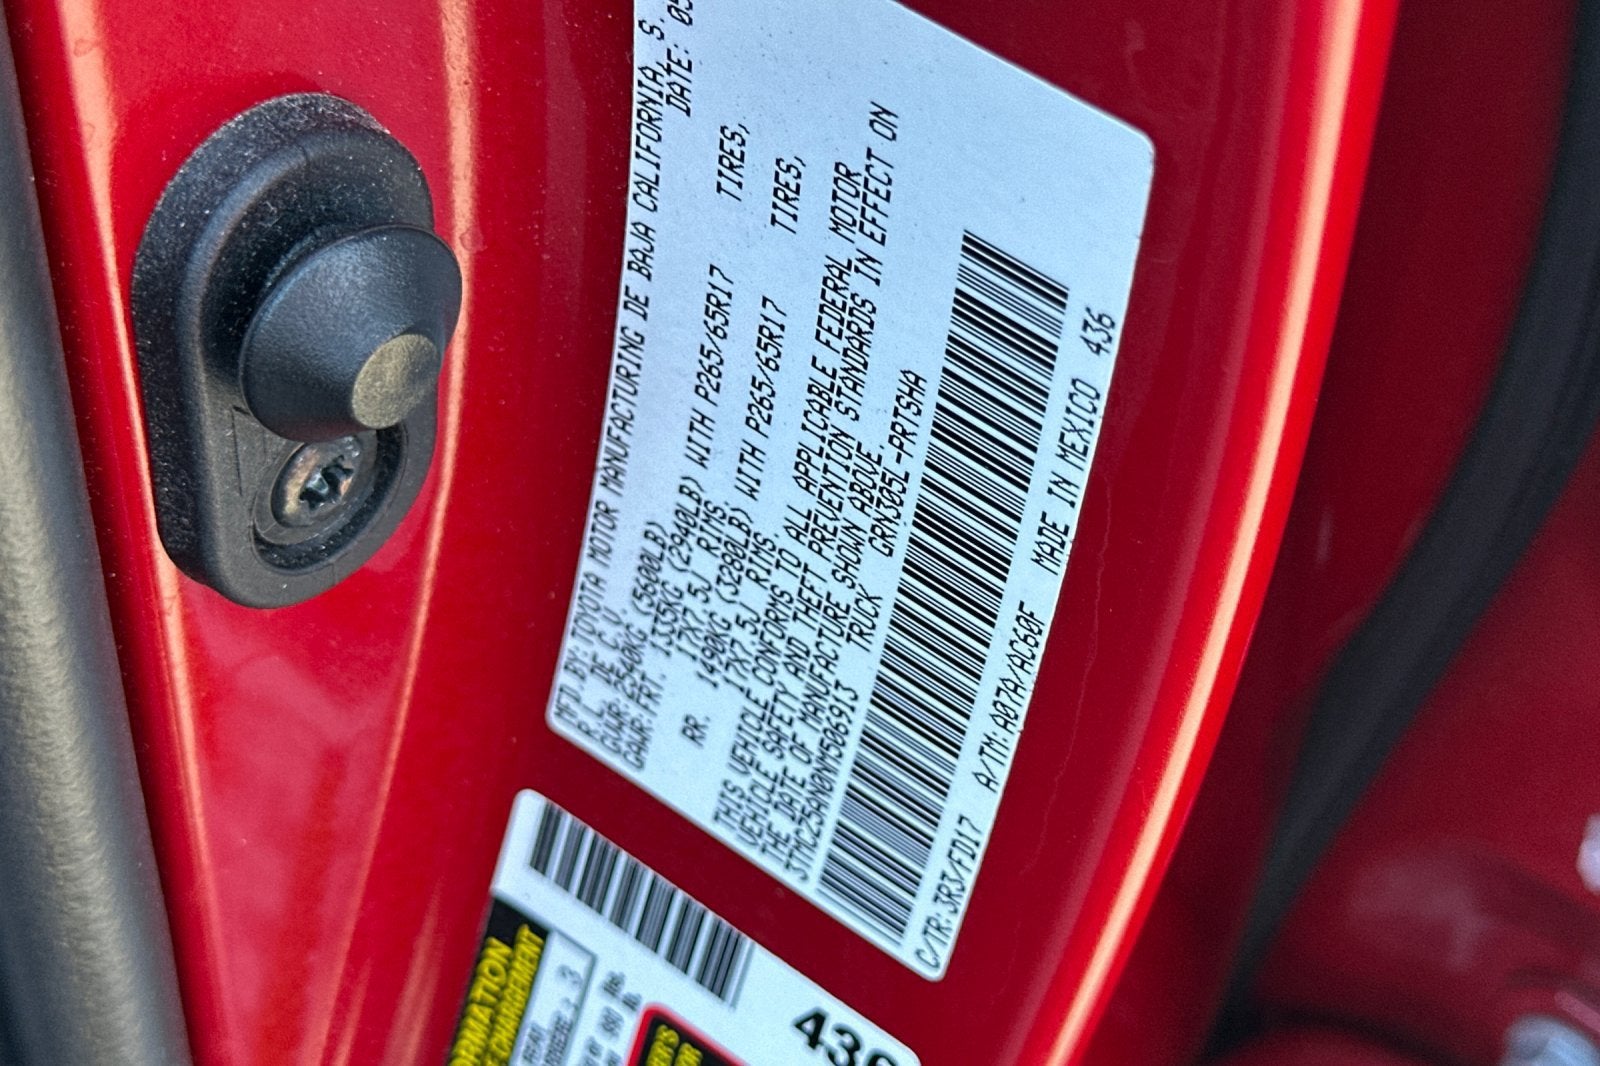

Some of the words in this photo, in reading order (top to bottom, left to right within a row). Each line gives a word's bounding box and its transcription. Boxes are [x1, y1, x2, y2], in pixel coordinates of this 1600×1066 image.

[638, 19, 664, 40] S.
[666, 44, 692, 117] DATE:
[633, 62, 668, 212] CALIFORNIA,
[869, 101, 898, 141] ON
[717, 124, 750, 201] TIRES,
[771, 156, 806, 234] TIRES,
[859, 147, 893, 246] EFFECT
[829, 162, 862, 244] MOTOR
[627, 222, 655, 281] BAJA
[854, 248, 883, 286] IN
[623, 285, 649, 321] DE
[695, 264, 733, 406] P265/65R17
[815, 255, 852, 354] FEDERAL
[1080, 307, 1115, 355] 436
[745, 296, 786, 438] P265/65R17
[834, 293, 876, 421] STANDARDS
[600, 326, 645, 496] MANUFACTURING
[685, 408, 715, 469] WITH
[792, 355, 837, 496] APPLICABLE
[1055, 378, 1100, 471] MEXICO
[735, 439, 766, 501] WITH
[808, 424, 855, 562] PREVENTION
[847, 441, 884, 517] ABOVE.
[1047, 471, 1079, 508] IN
[588, 500, 619, 567] MOTOR
[667, 476, 704, 572] (2940LB)
[783, 505, 812, 546] ALL
[846, 584, 882, 652] TRUCK
[868, 370, 927, 557] GRN305L-PRTSHA
[1031, 511, 1069, 575] MADE
[632, 522, 668, 616] (5600LB)
[676, 571, 712, 661] 17X7.5J
[696, 501, 729, 558] RIMS.
[715, 508, 753, 603] (3280LB)
[775, 548, 801, 578] TO
[831, 517, 867, 589] SHOWN
[650, 581, 684, 657] 1335KG
[724, 602, 760, 693] 17X7.5J
[745, 532, 779, 590] RIMS.
[792, 563, 827, 630] THEFT
[590, 653, 615, 685] DE
[697, 612, 732, 688] 1490KG
[752, 585, 794, 686] CONFORMS
[783, 637, 810, 681] AND
[798, 591, 851, 732] MANUFACTURE
[681, 715, 709, 746] RR.
[729, 688, 769, 775] VEHICLE
[762, 681, 799, 760] SAFETY
[789, 732, 813, 765] OF
[713, 780, 746, 829] THIS
[738, 761, 779, 846] VEHICLE
[773, 766, 806, 822] DATE
[761, 822, 791, 865] THE
